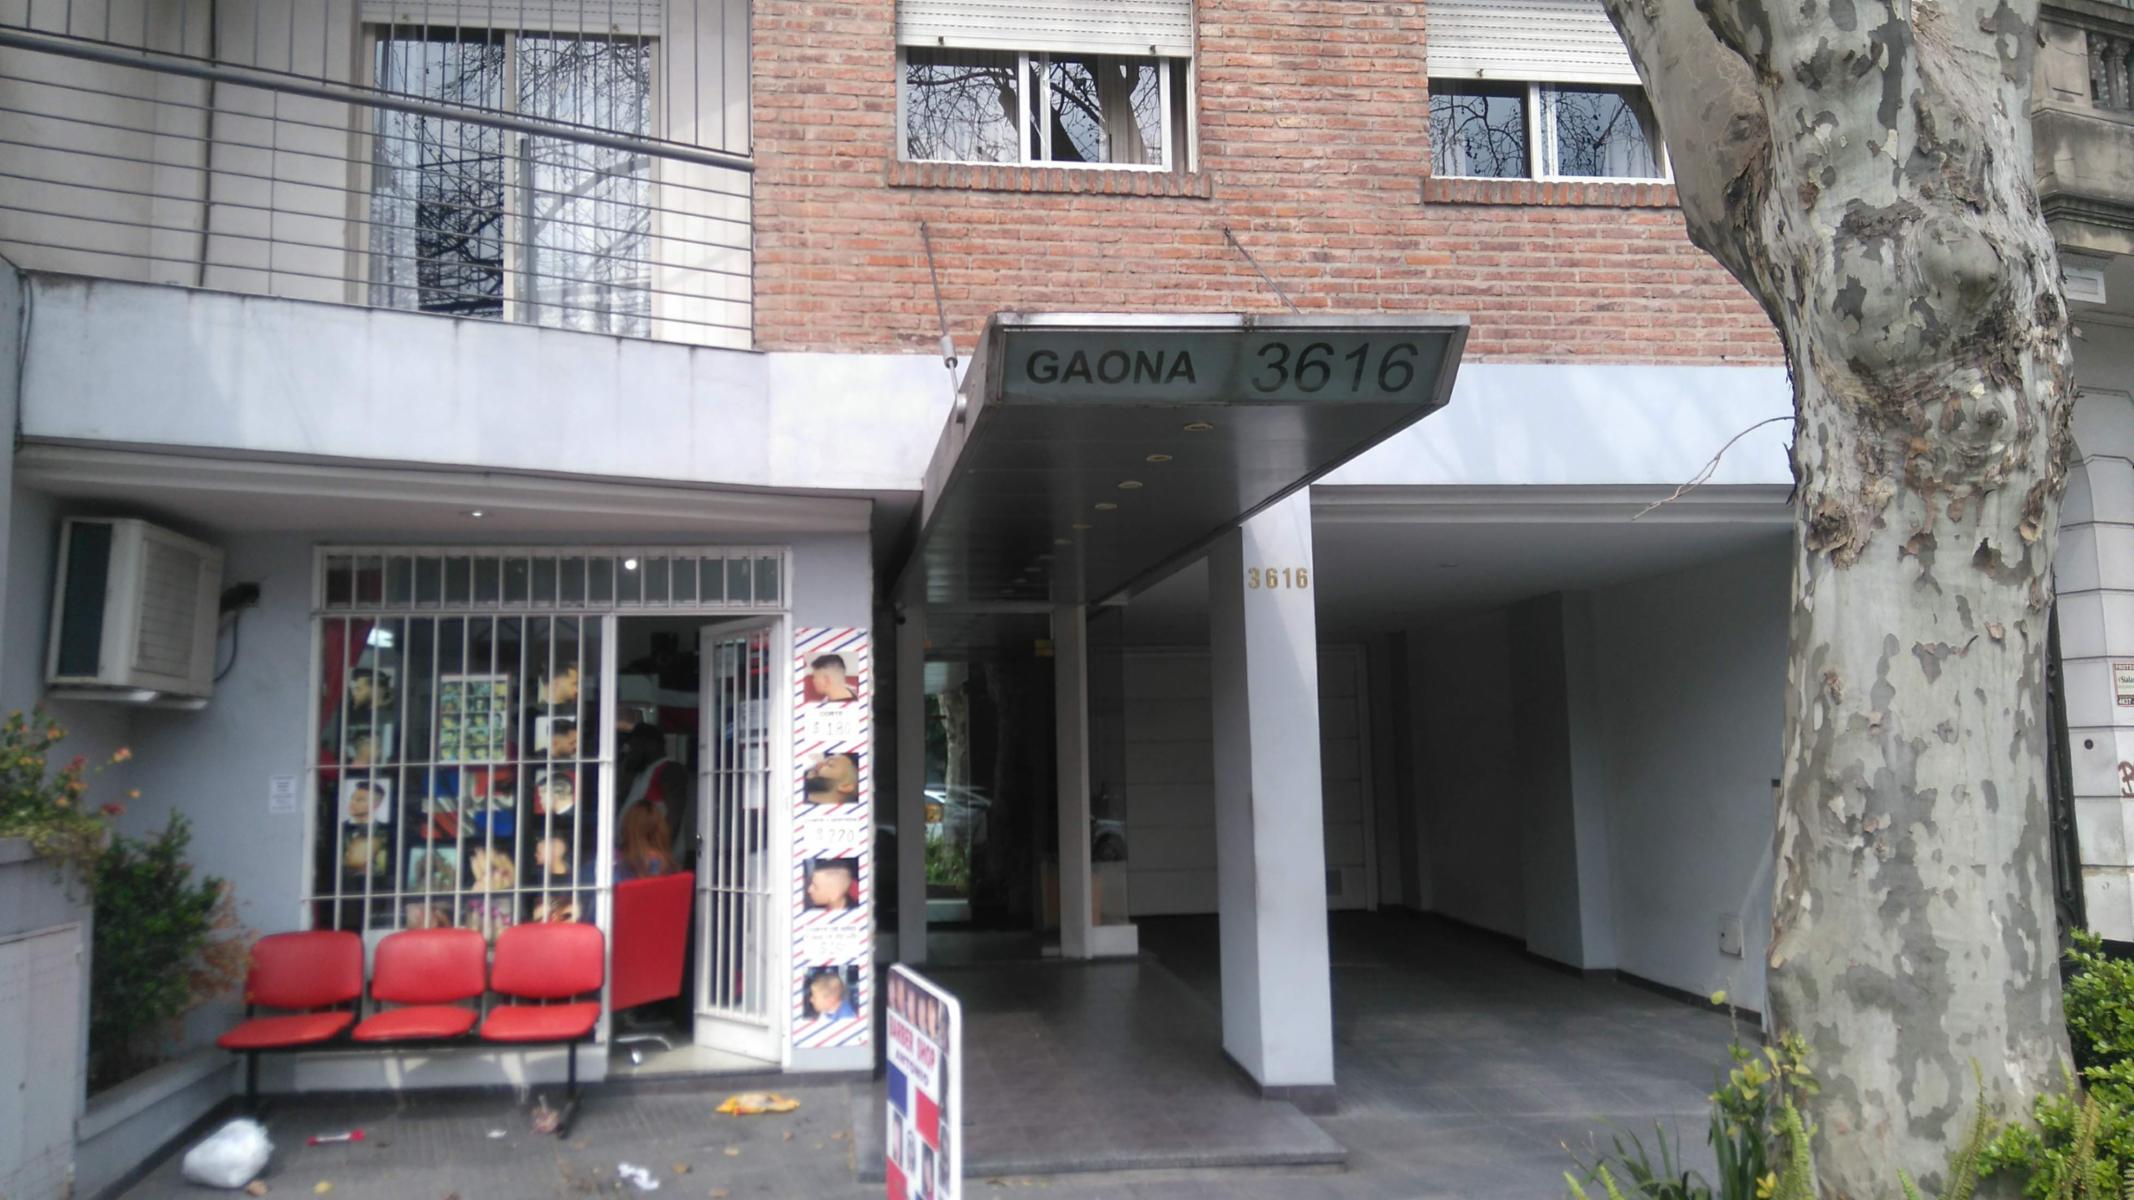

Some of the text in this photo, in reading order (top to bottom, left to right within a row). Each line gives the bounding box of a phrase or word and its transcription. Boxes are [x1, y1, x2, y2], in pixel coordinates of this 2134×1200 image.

[1025, 341, 1419, 393] GAONA 3616
[1247, 567, 1309, 590] 3616
[917, 1037, 936, 1071] SHOP
